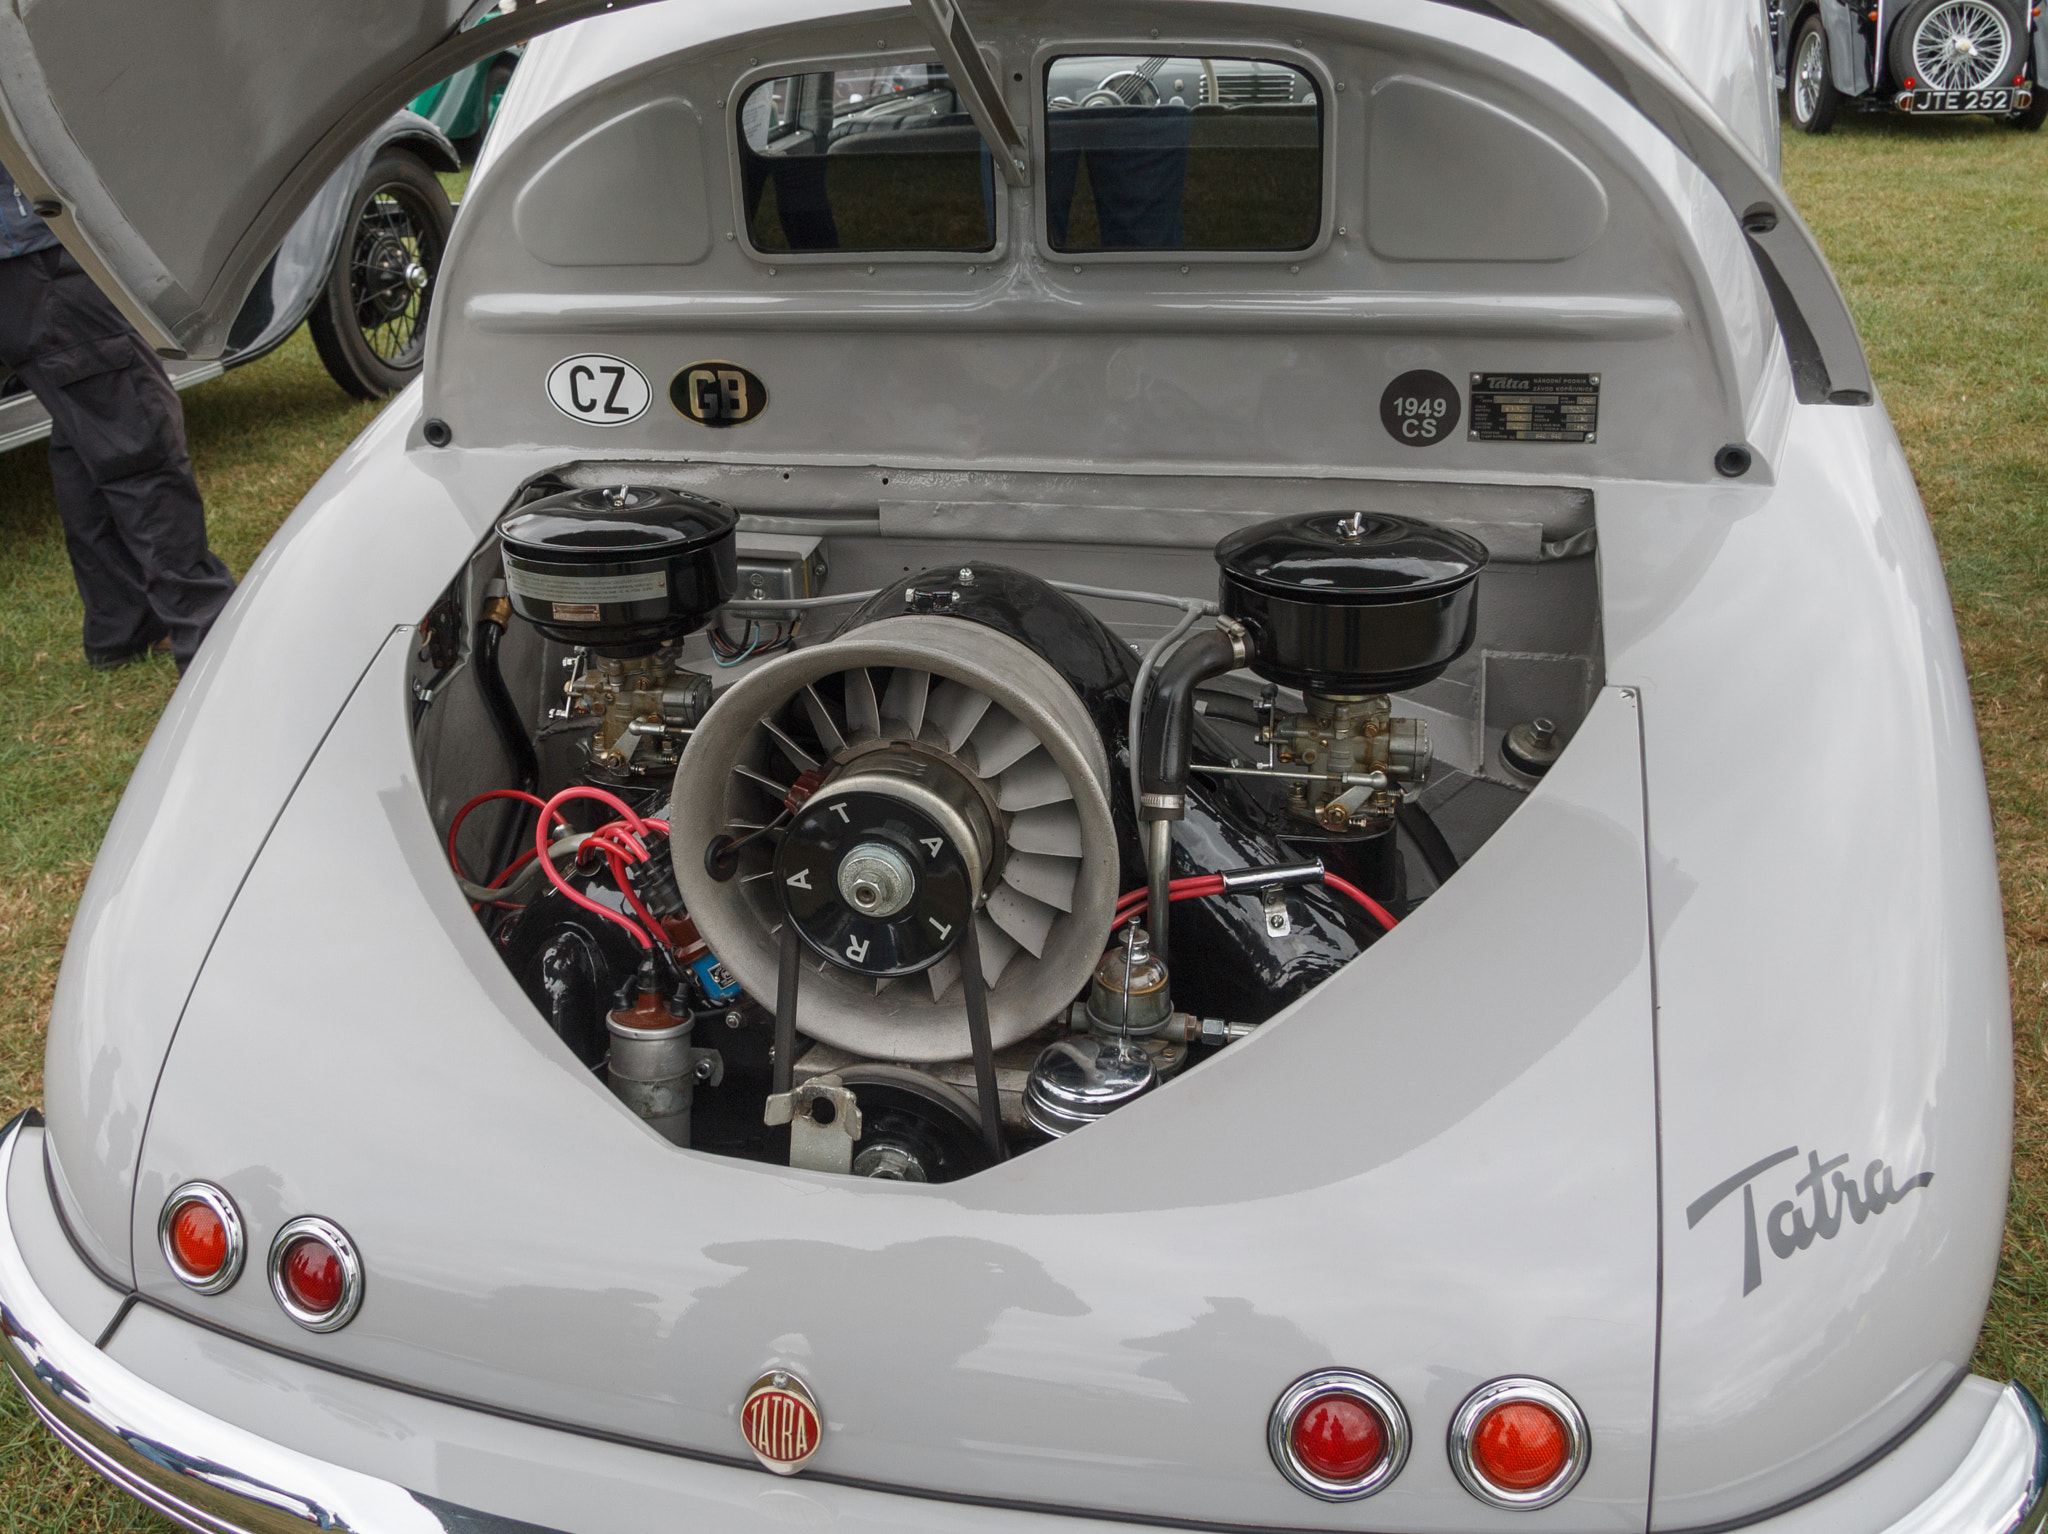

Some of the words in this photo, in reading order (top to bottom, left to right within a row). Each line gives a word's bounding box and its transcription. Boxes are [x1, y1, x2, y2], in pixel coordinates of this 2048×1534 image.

[1917, 91, 1961, 110] JTE
[1964, 90, 2008, 110] 252
[569, 365, 630, 415] CZ
[688, 369, 748, 419] GB
[1486, 377, 1530, 389] Tatra
[1393, 397, 1447, 418] 1949
[1402, 418, 1438, 438] CS
[1686, 1145, 1935, 1298] Tatra
[750, 1395, 809, 1460] TATRA
